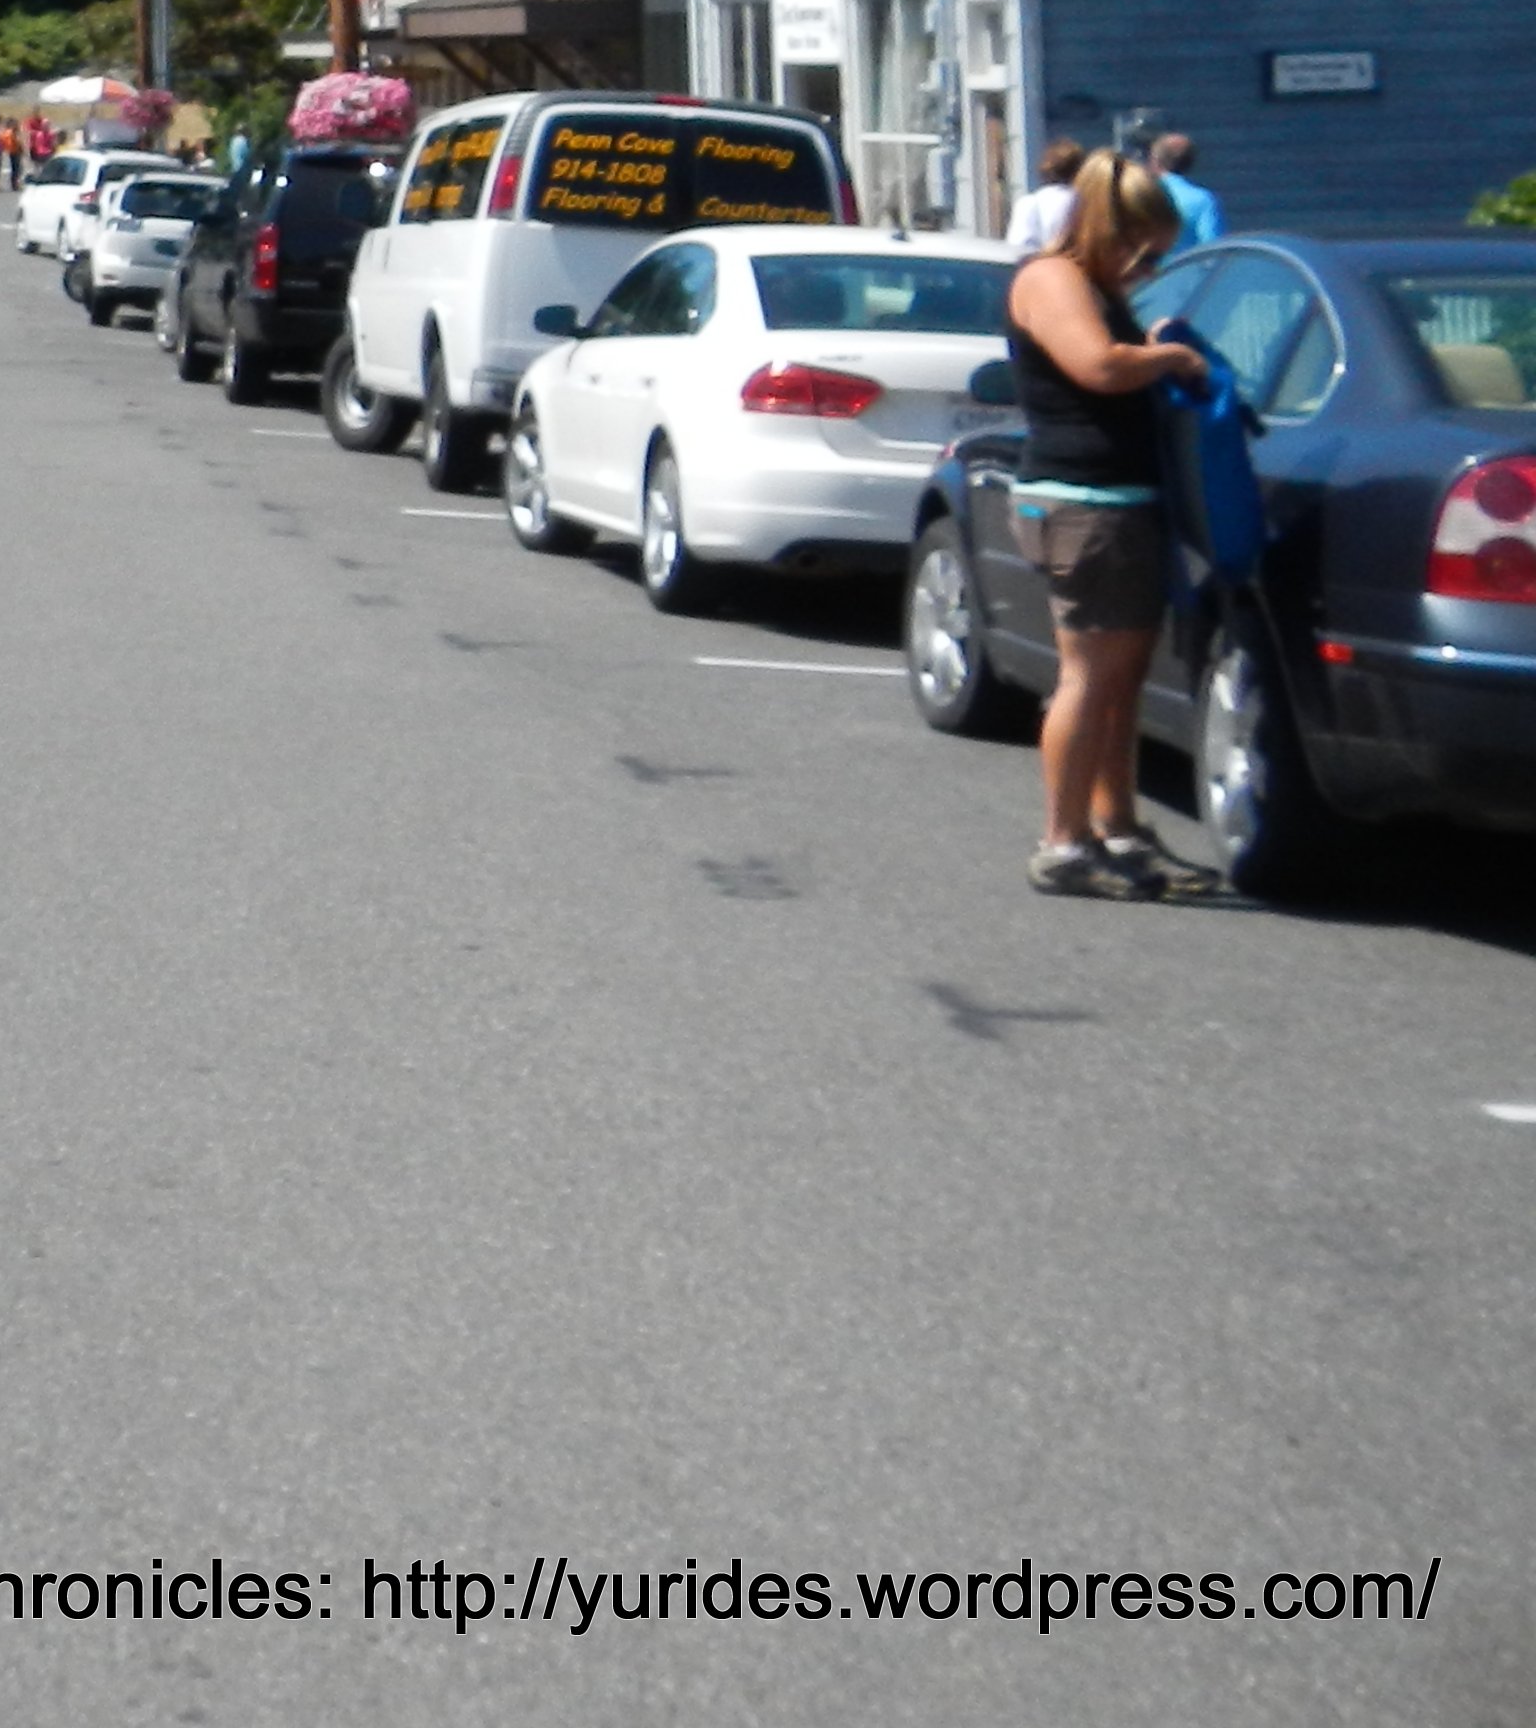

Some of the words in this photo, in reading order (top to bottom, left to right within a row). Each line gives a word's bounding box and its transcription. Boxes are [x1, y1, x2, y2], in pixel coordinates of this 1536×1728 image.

[554, 128, 612, 150] Penn
[618, 132, 675, 155] Cove
[696, 136, 796, 170] Flooring
[551, 158, 667, 184] 914-1808
[541, 186, 643, 218] Flooring
[647, 193, 666, 214] &
